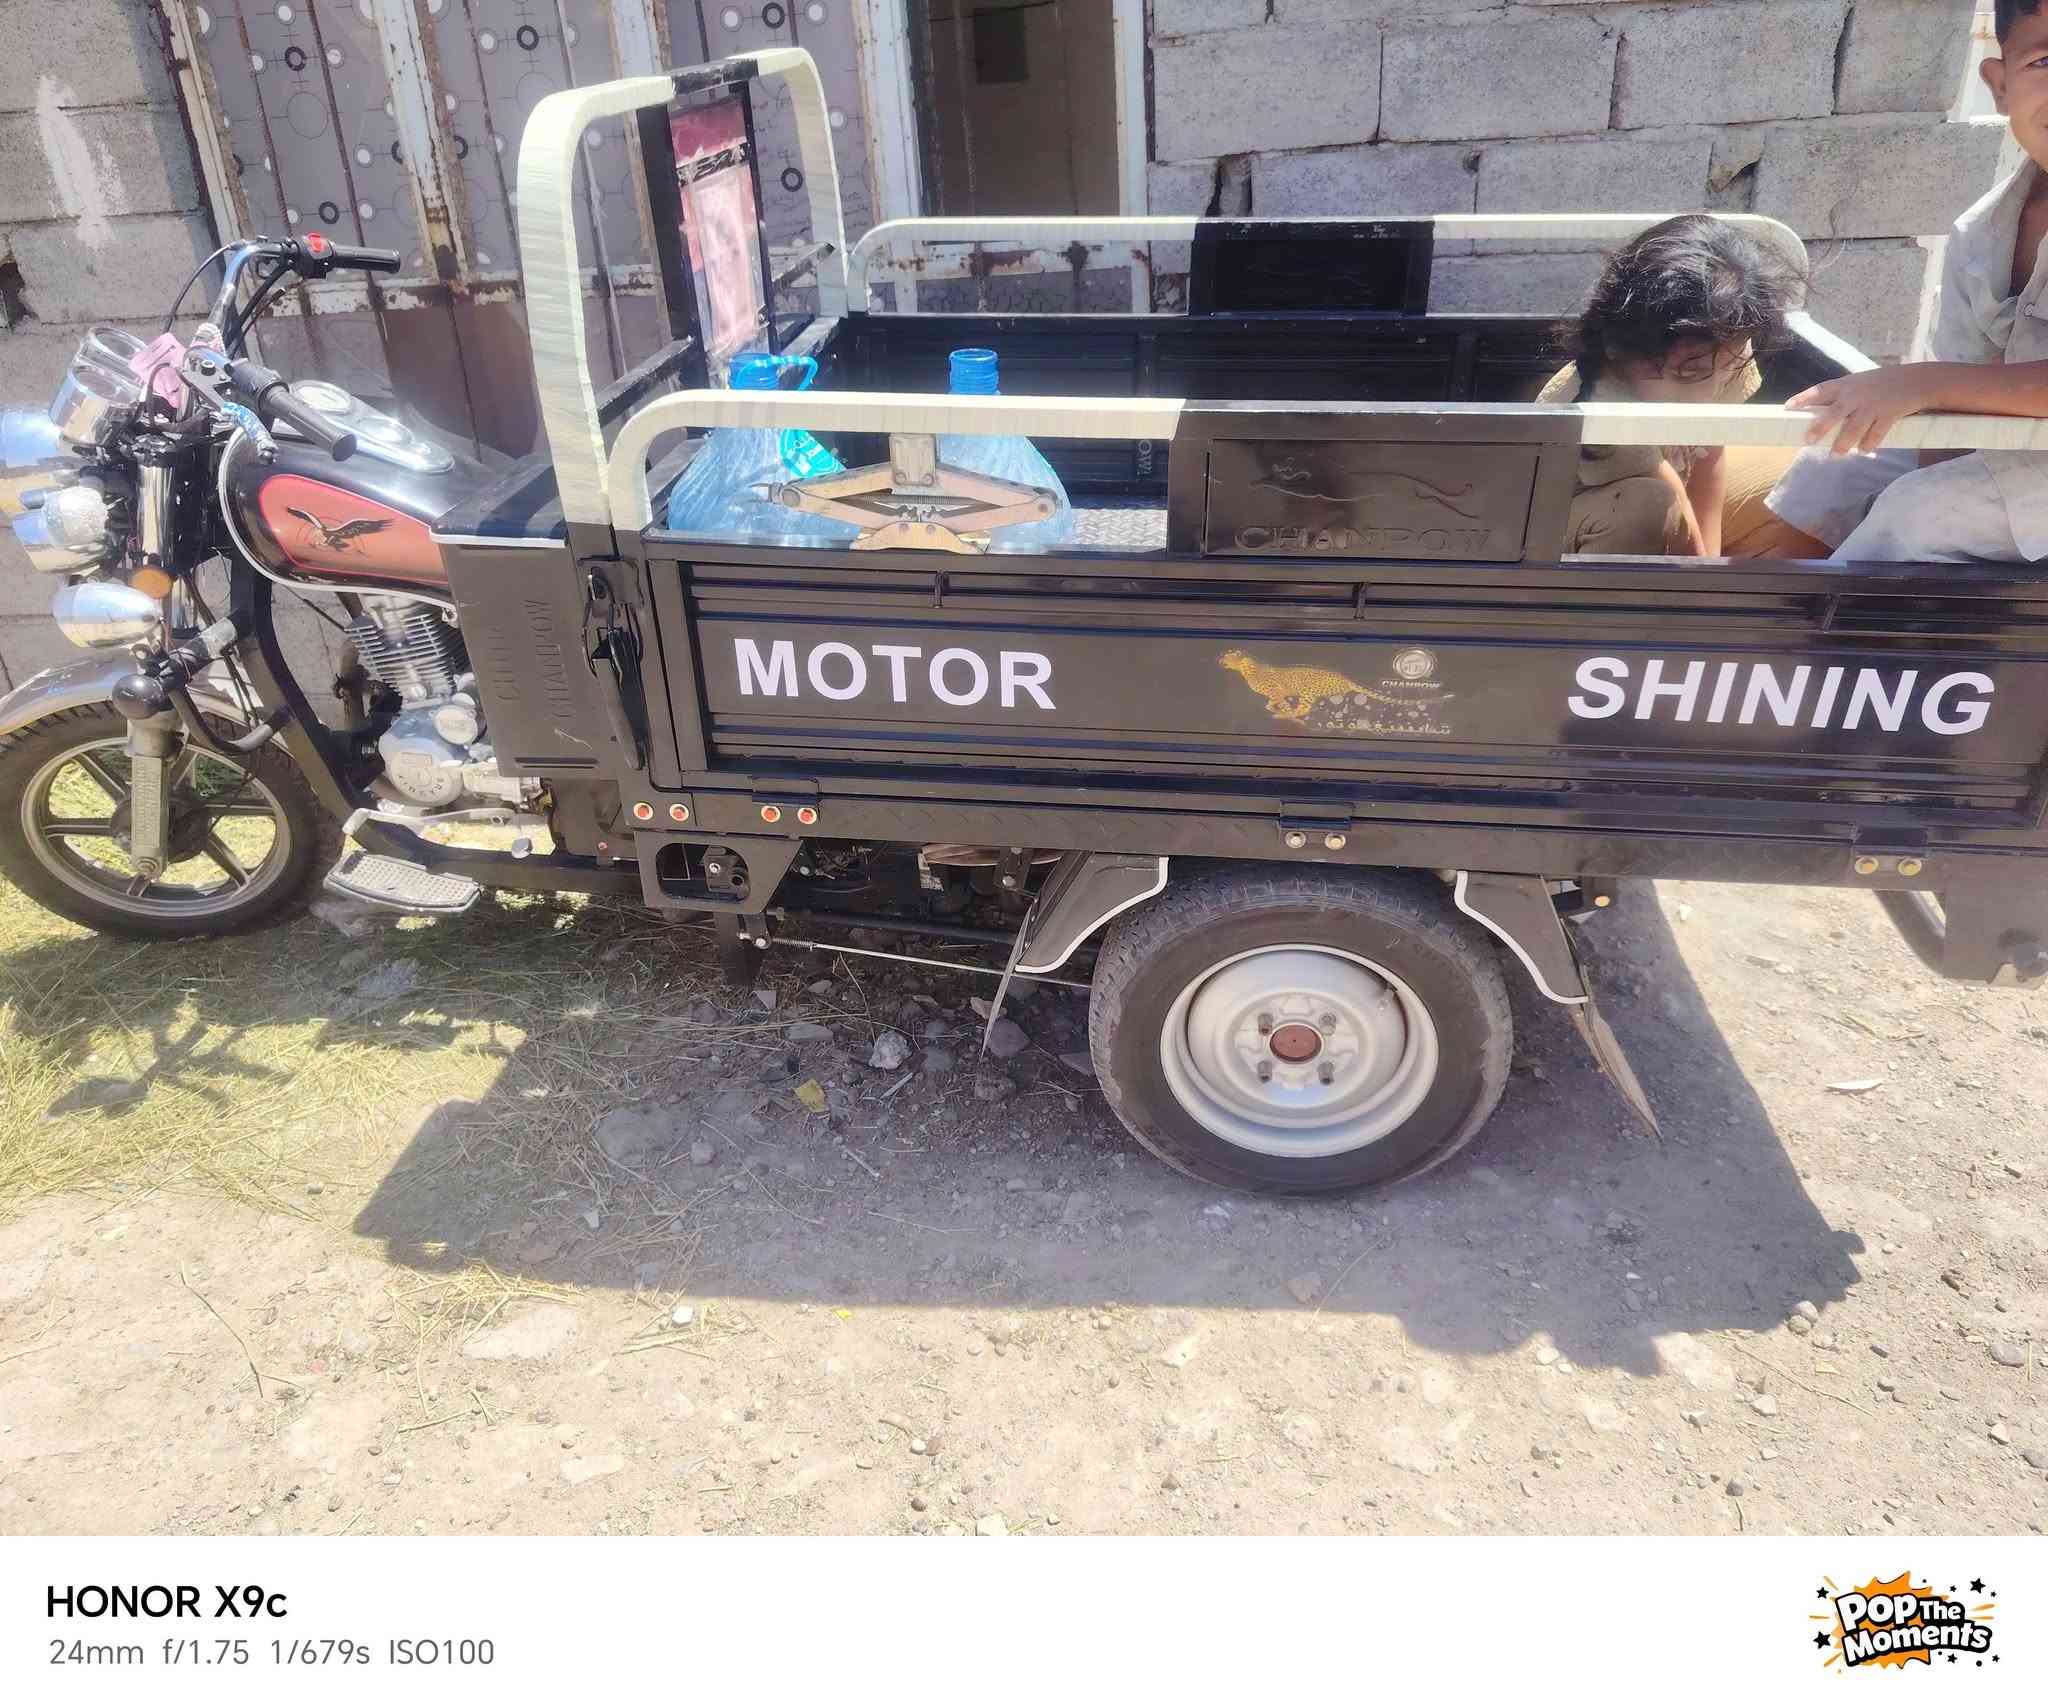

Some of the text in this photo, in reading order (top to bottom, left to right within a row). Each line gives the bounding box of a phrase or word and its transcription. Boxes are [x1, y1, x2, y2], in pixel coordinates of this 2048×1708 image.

[1234, 525, 1492, 554] CHANPOW
[734, 638, 1056, 710] MOTOR
[1568, 656, 1995, 735] SHINING
